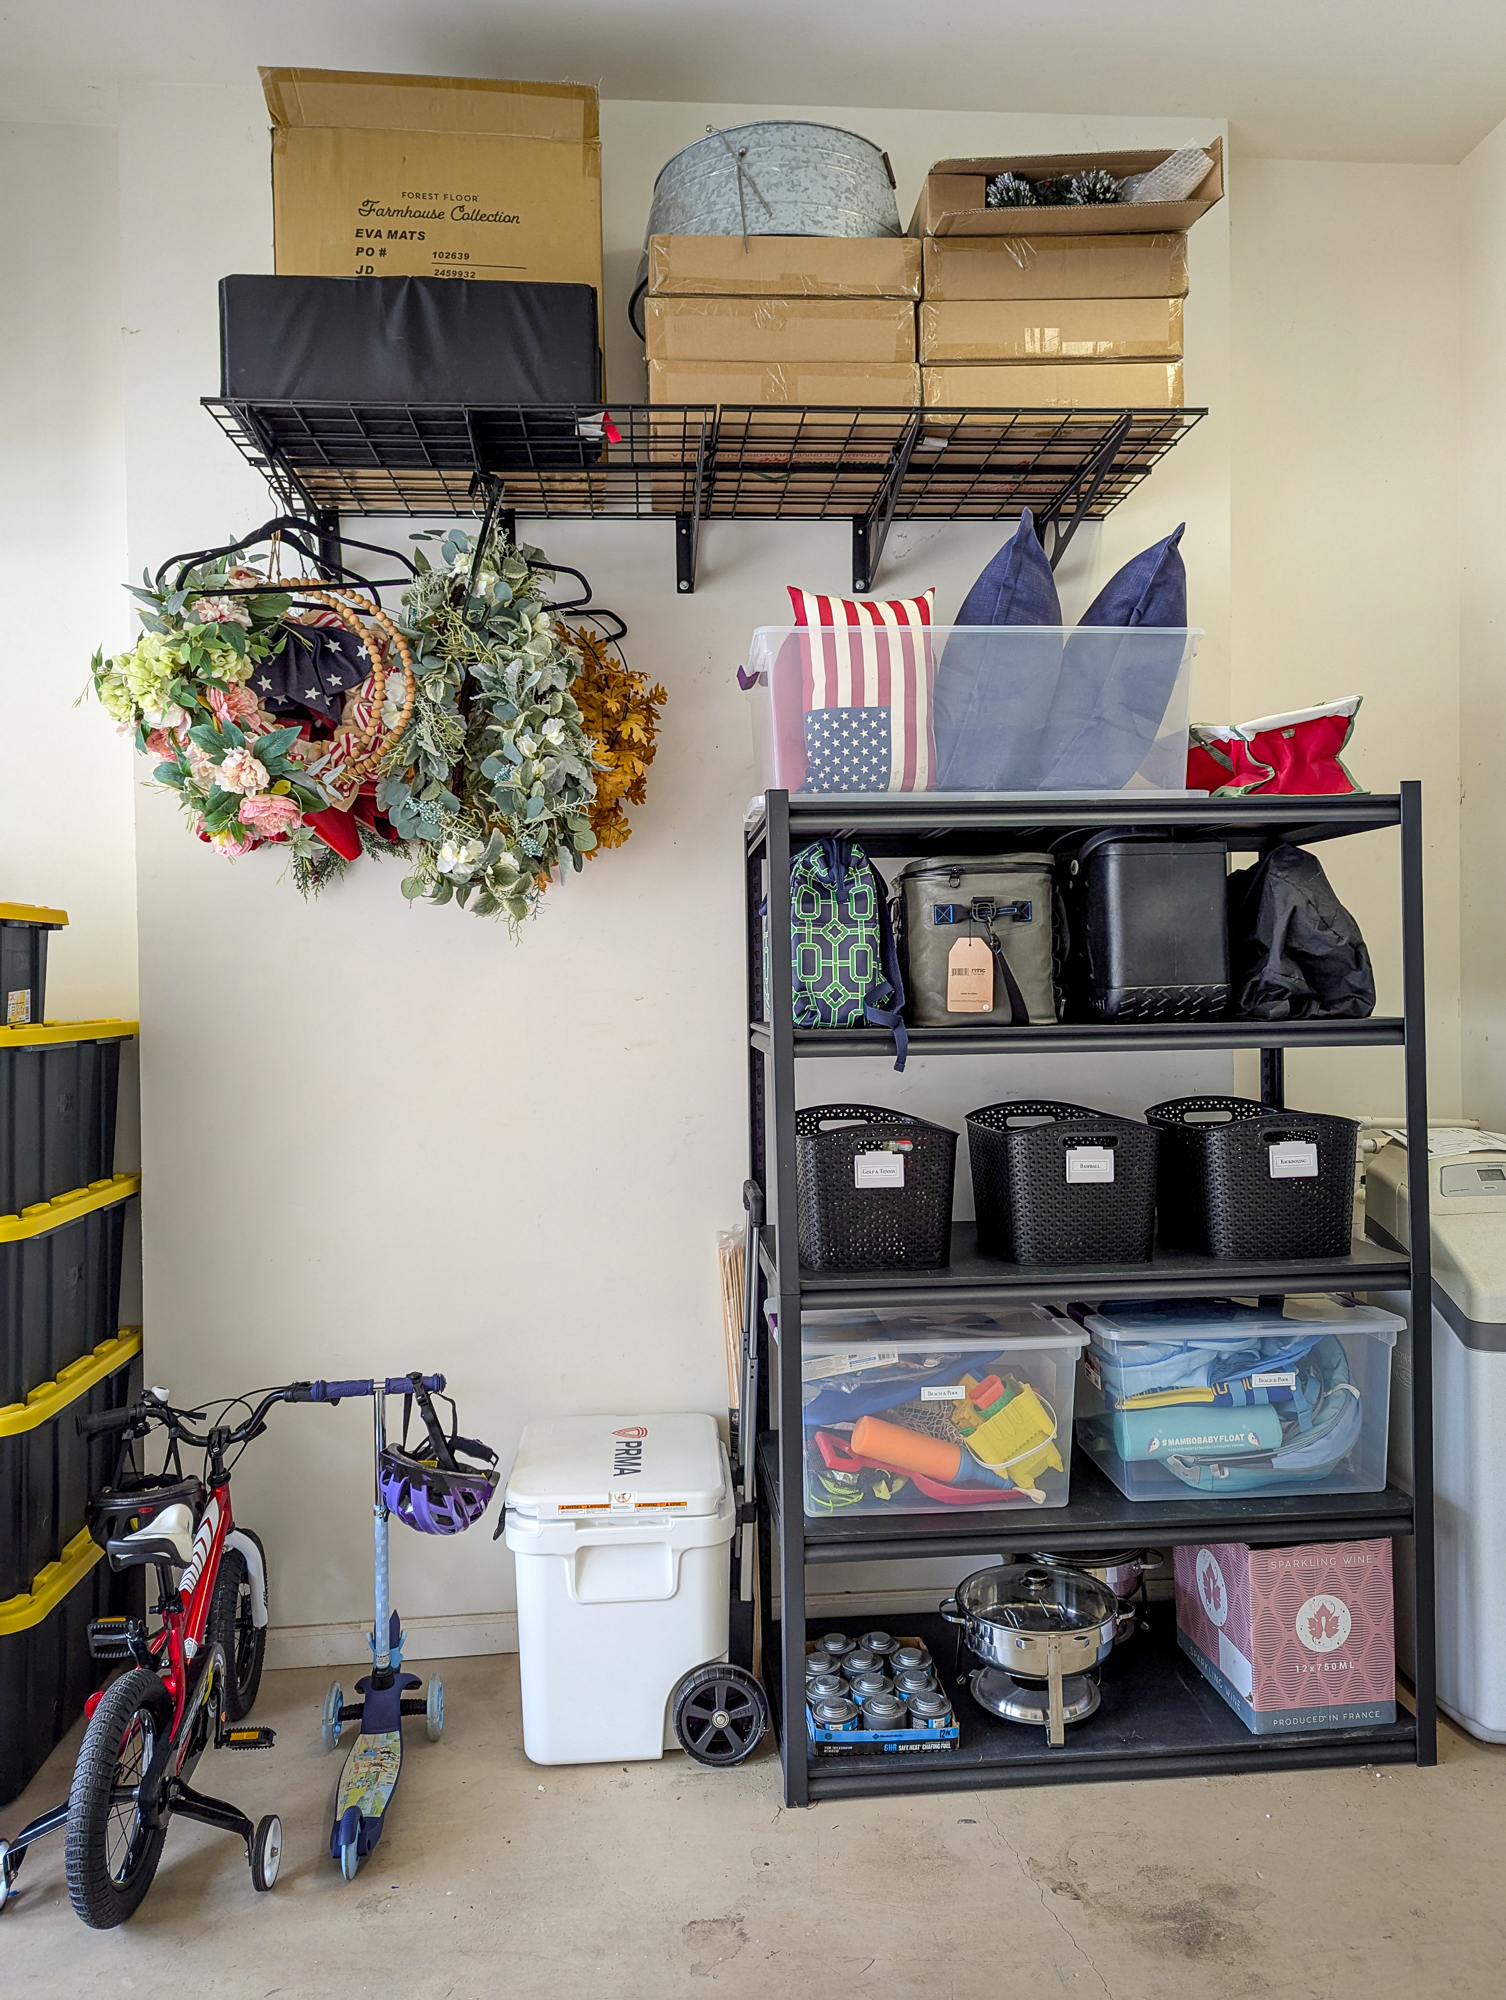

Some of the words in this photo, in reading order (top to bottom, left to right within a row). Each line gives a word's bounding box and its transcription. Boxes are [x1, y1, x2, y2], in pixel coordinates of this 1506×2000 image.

[401, 191, 439, 201] FOREST
[443, 193, 478, 202] FLOOR
[358, 199, 445, 220] Farmhouse
[450, 204, 520, 224] Collection
[355, 228, 383, 239] EVA
[387, 230, 426, 241] MATS
[355, 247, 375, 257] PO
[378, 247, 387, 258] #
[432, 251, 470, 260] 102639
[355, 265, 374, 275] JD
[433, 269, 476, 278] 2459932
[613, 1441, 642, 1476] PRMA
[1270, 1558, 1337, 1569] SPARKLING
[1343, 1555, 1373, 1566] WINE
[1295, 1662, 1355, 1673] 12x750ML
[1190, 1646, 1222, 1689] SPARKLING
[1224, 1685, 1240, 1710] WINE
[1273, 1716, 1325, 1726] PRODUCED
[1343, 1710, 1380, 1720] FRANCE
